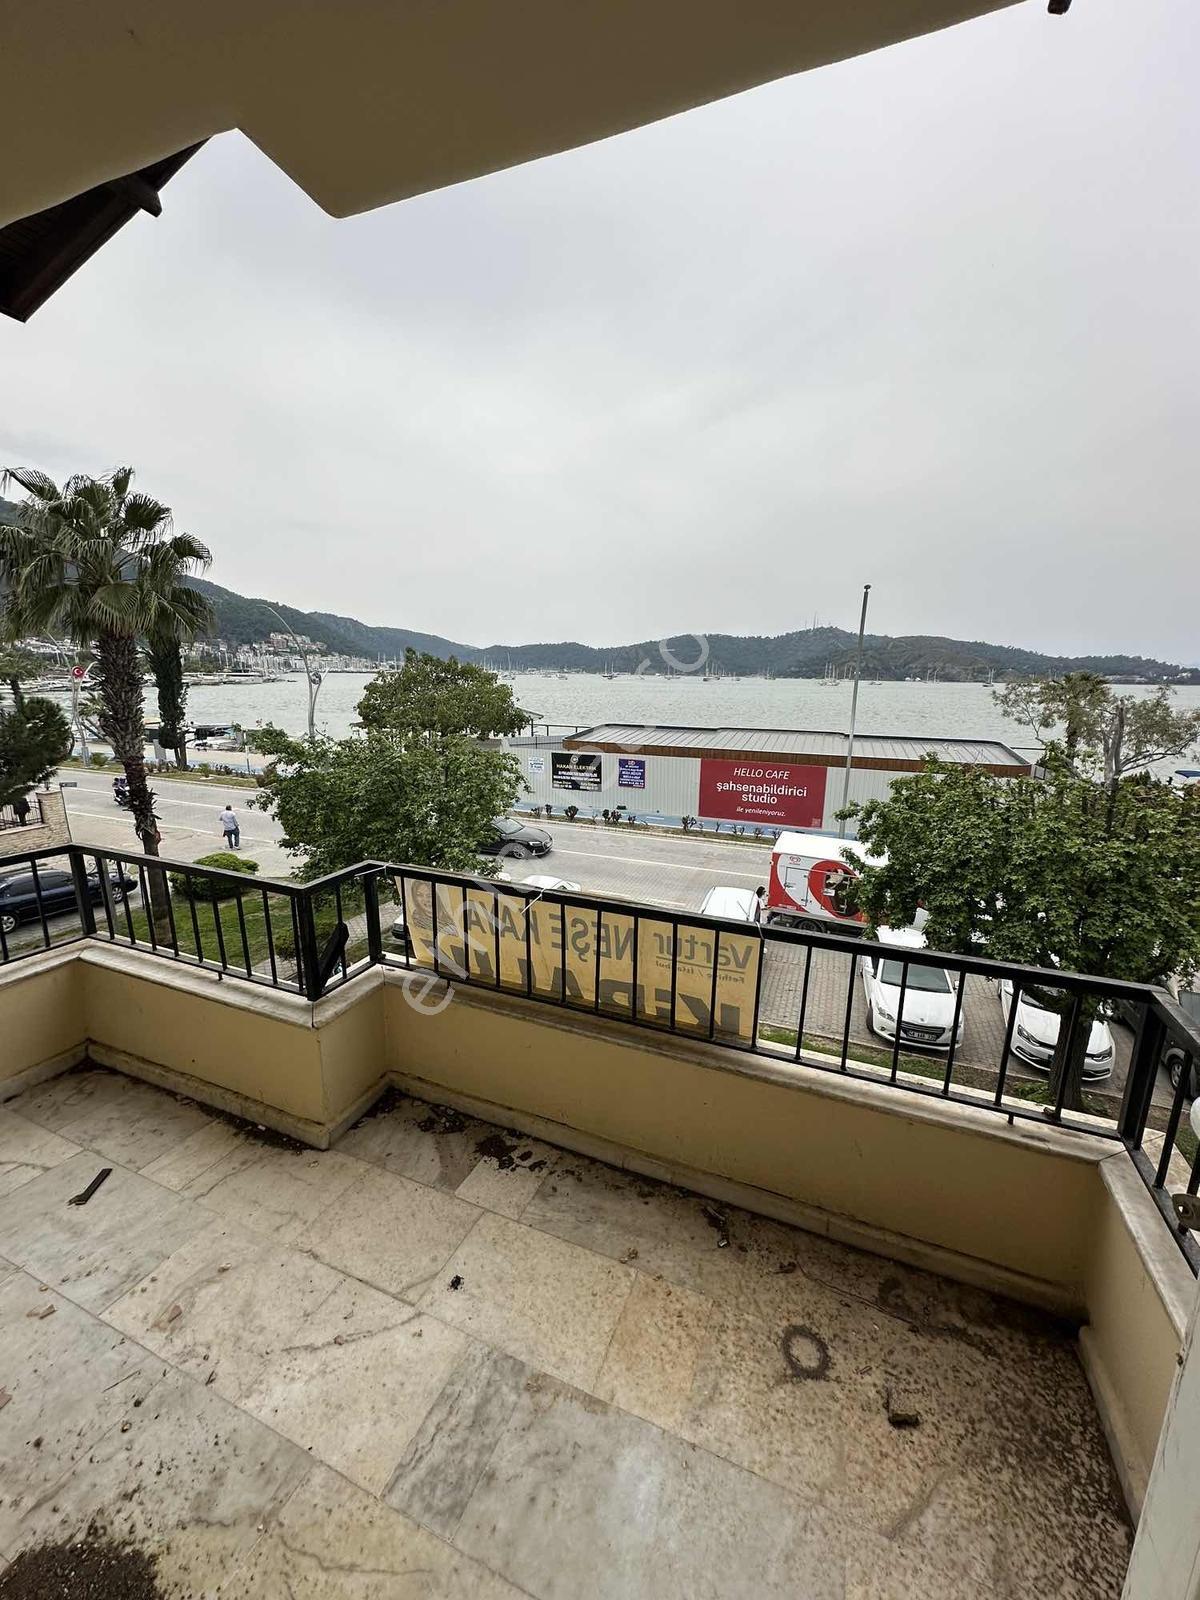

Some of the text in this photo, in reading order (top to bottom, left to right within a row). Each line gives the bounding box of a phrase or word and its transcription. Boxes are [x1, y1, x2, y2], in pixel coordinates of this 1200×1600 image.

[734, 767, 790, 780] HELLO CAFE
[716, 781, 807, 797] şahsenabildirici
[741, 793, 777, 804] studio
[744, 807, 786, 817] yenileniyoruz.
